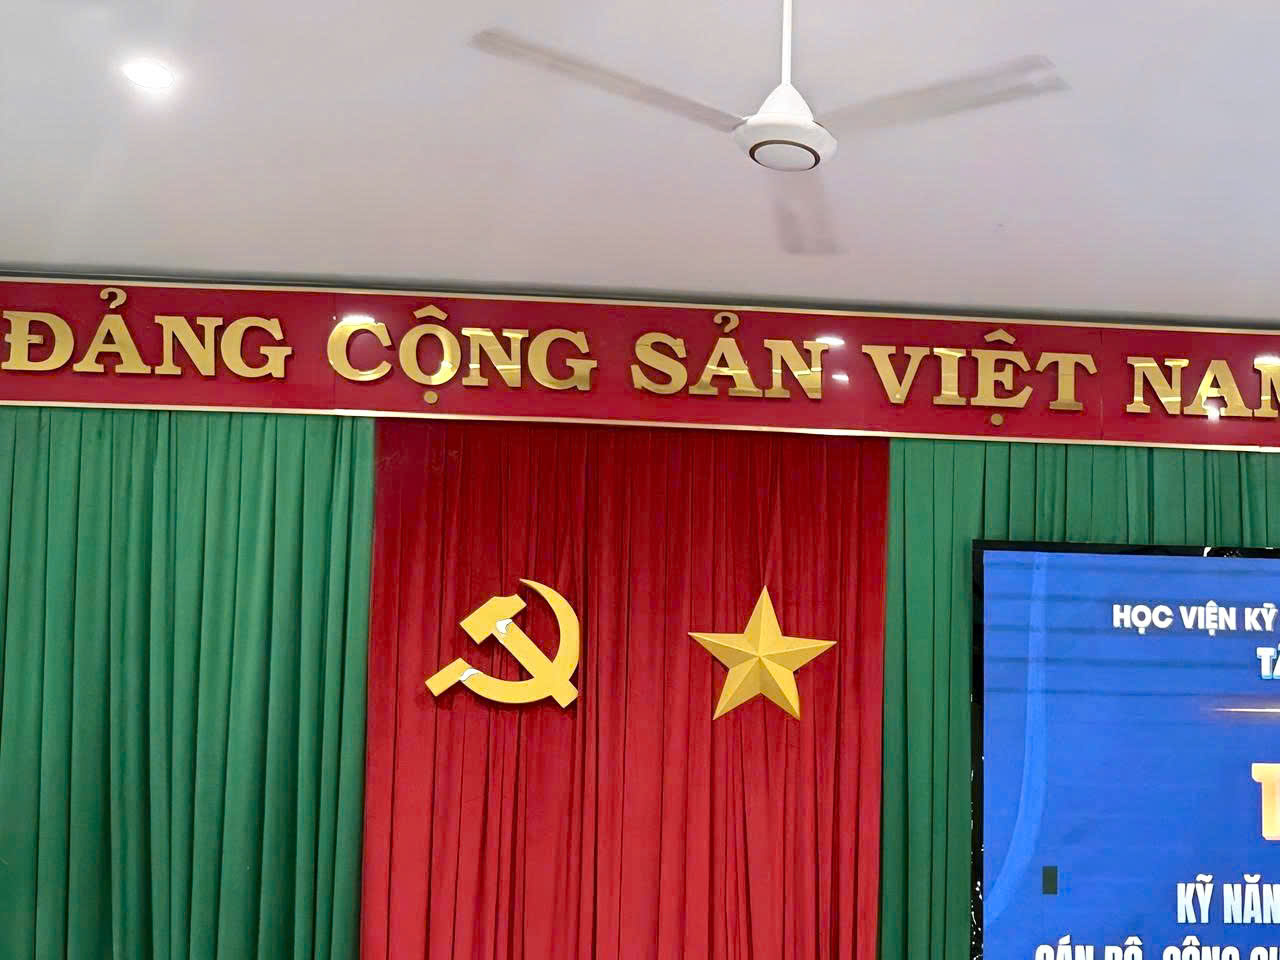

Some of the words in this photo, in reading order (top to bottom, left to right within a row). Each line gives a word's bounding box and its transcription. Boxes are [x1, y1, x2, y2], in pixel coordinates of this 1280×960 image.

[2, 287, 293, 379] ĐẢNG
[328, 305, 598, 404] CỘNG
[631, 312, 825, 401] SẢN
[862, 329, 1097, 425] VIỆT
[1112, 604, 1173, 635] HỌC
[1178, 600, 1236, 636] VIỆN
[1245, 603, 1277, 632] KỸ
[1177, 873, 1214, 924] KỸ
